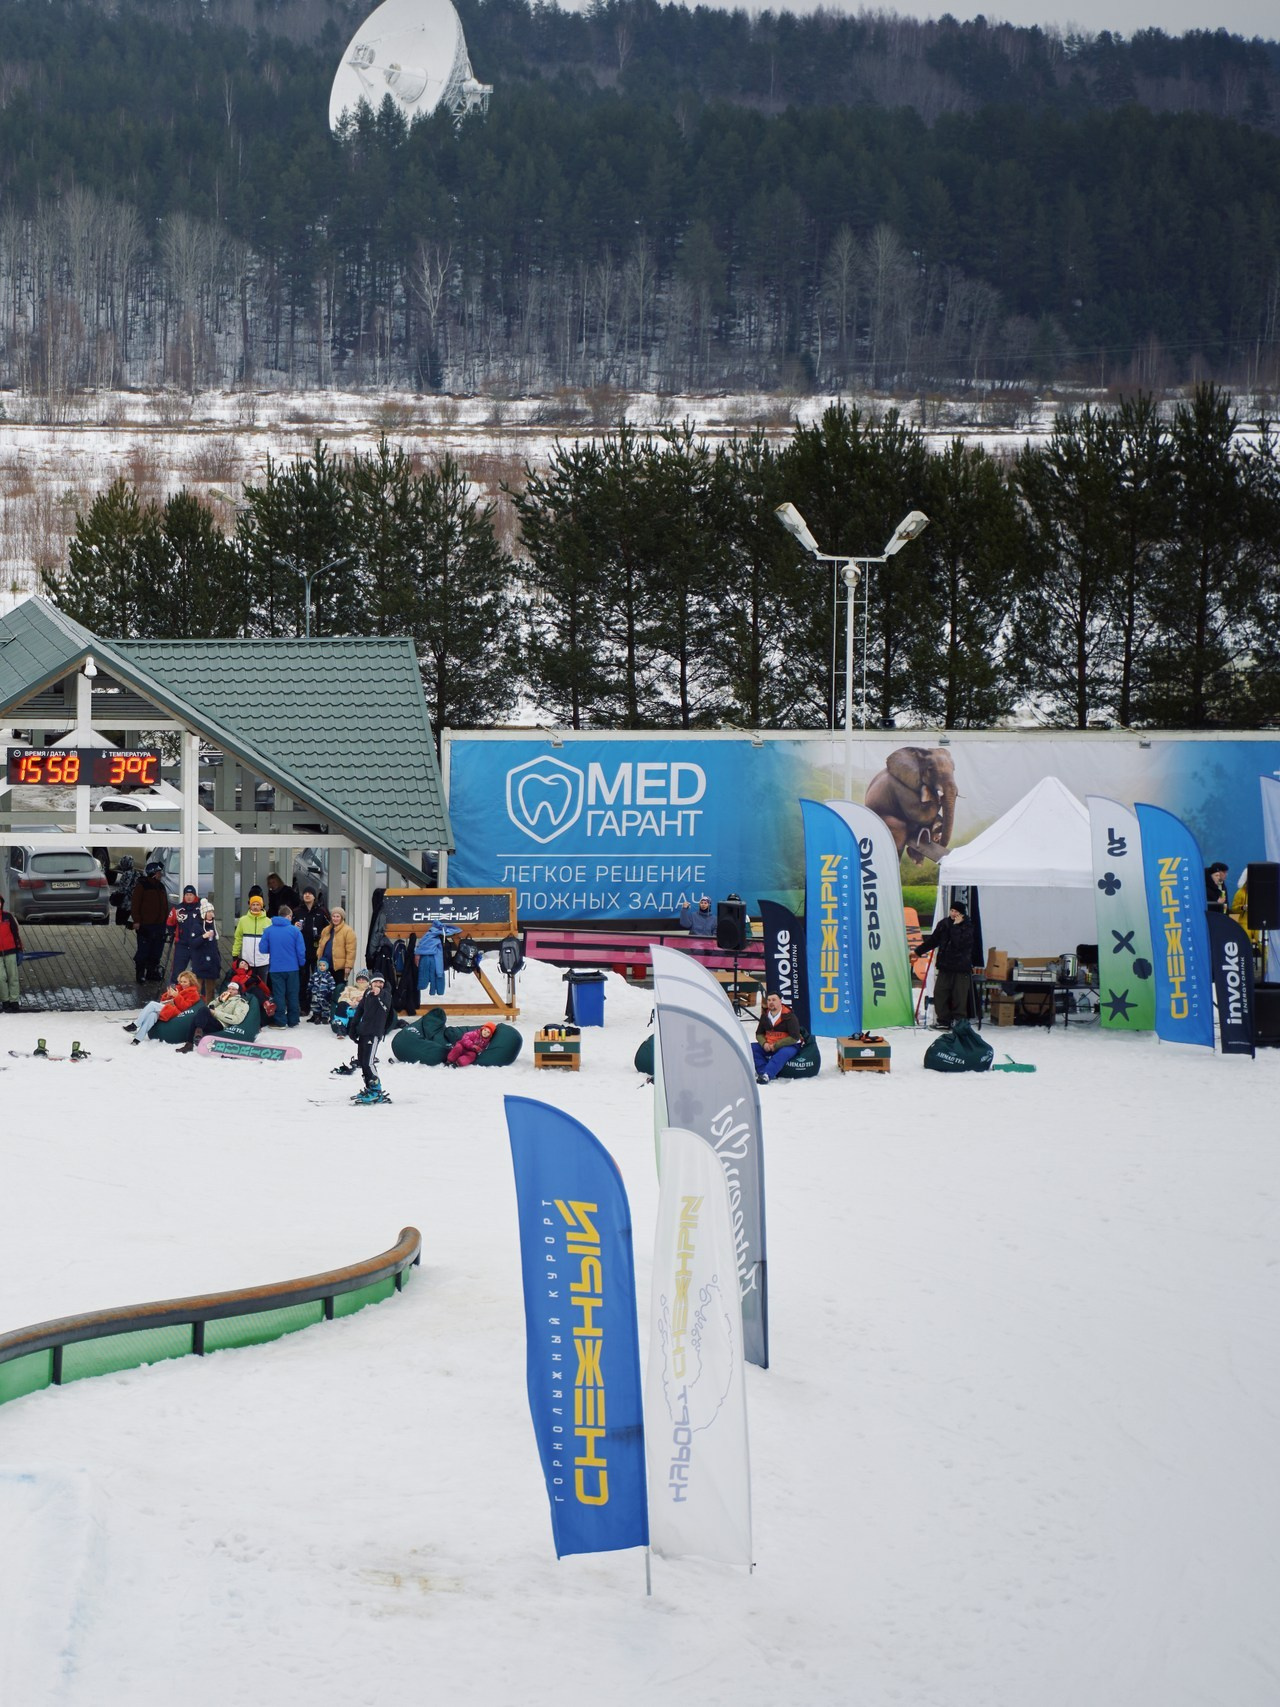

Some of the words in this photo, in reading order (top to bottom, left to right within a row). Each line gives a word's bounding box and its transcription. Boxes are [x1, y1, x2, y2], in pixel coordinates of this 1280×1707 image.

[24, 750, 47, 758] ВРЕМЯ
[50, 750, 67, 758] ДАТА
[20, 756, 42, 783] 15
[47, 756, 80, 784] 58
[587, 762, 707, 806] MED
[586, 810, 704, 837] ГАРАНТ
[501, 865, 587, 884] ЛЕГКОЕ
[595, 865, 706, 883] РЕШЕНИЕ
[412, 909, 480, 921] СНЕЖНЫЙ
[516, 892, 620, 911] ЛОЖНЫХ
[629, 892, 705, 912] ЗАДАЧ
[774, 930, 793, 1008] nvoke
[1222, 941, 1243, 1025] invoke
[214, 1042, 283, 1060] BURTON
[805, 1060, 815, 1068] TEA
[936, 1051, 956, 1062] AHMAD
[955, 1057, 966, 1066] TEA
[541, 1199, 559, 1298] КУРОРТ
[553, 1199, 609, 1506] СНЕЖНЫЙ
[548, 1317, 565, 1502] ГОРНОЛЫЖНЫЙ
